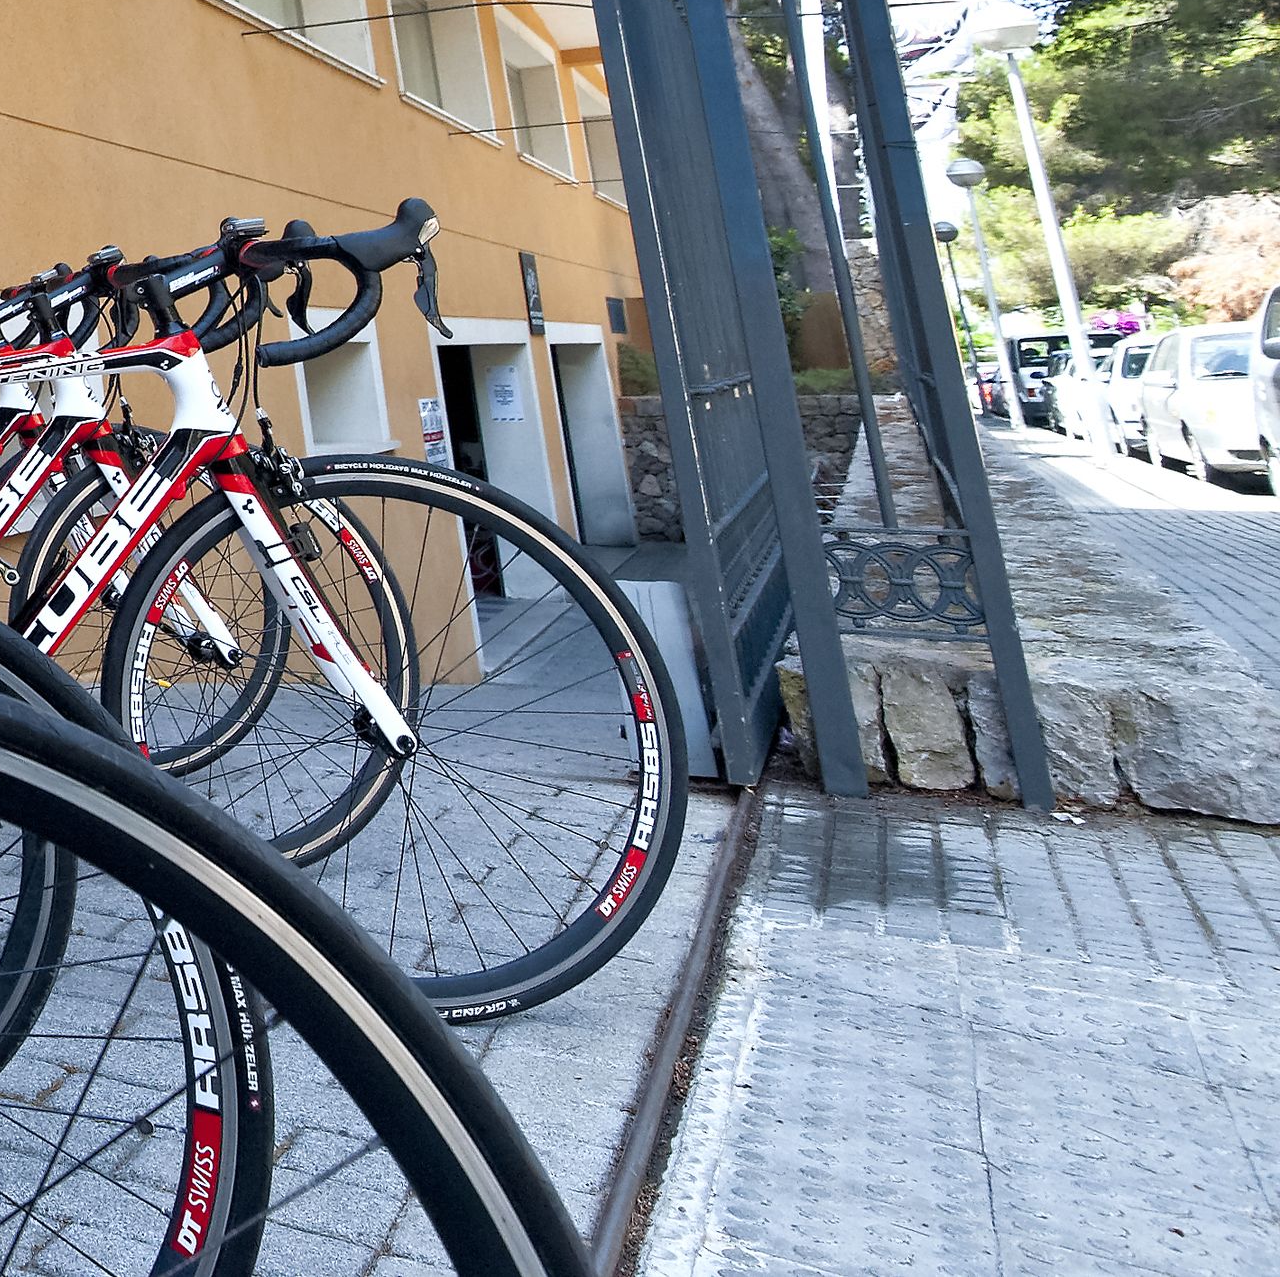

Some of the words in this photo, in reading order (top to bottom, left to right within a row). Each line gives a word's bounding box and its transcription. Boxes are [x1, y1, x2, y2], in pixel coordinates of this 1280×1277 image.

[154, 578, 178, 611] SWISS
[597, 893, 619, 918] DT
[611, 862, 638, 901] SWISS
[188, 1144, 215, 1214] SWISS
[174, 1208, 203, 1256] DT
